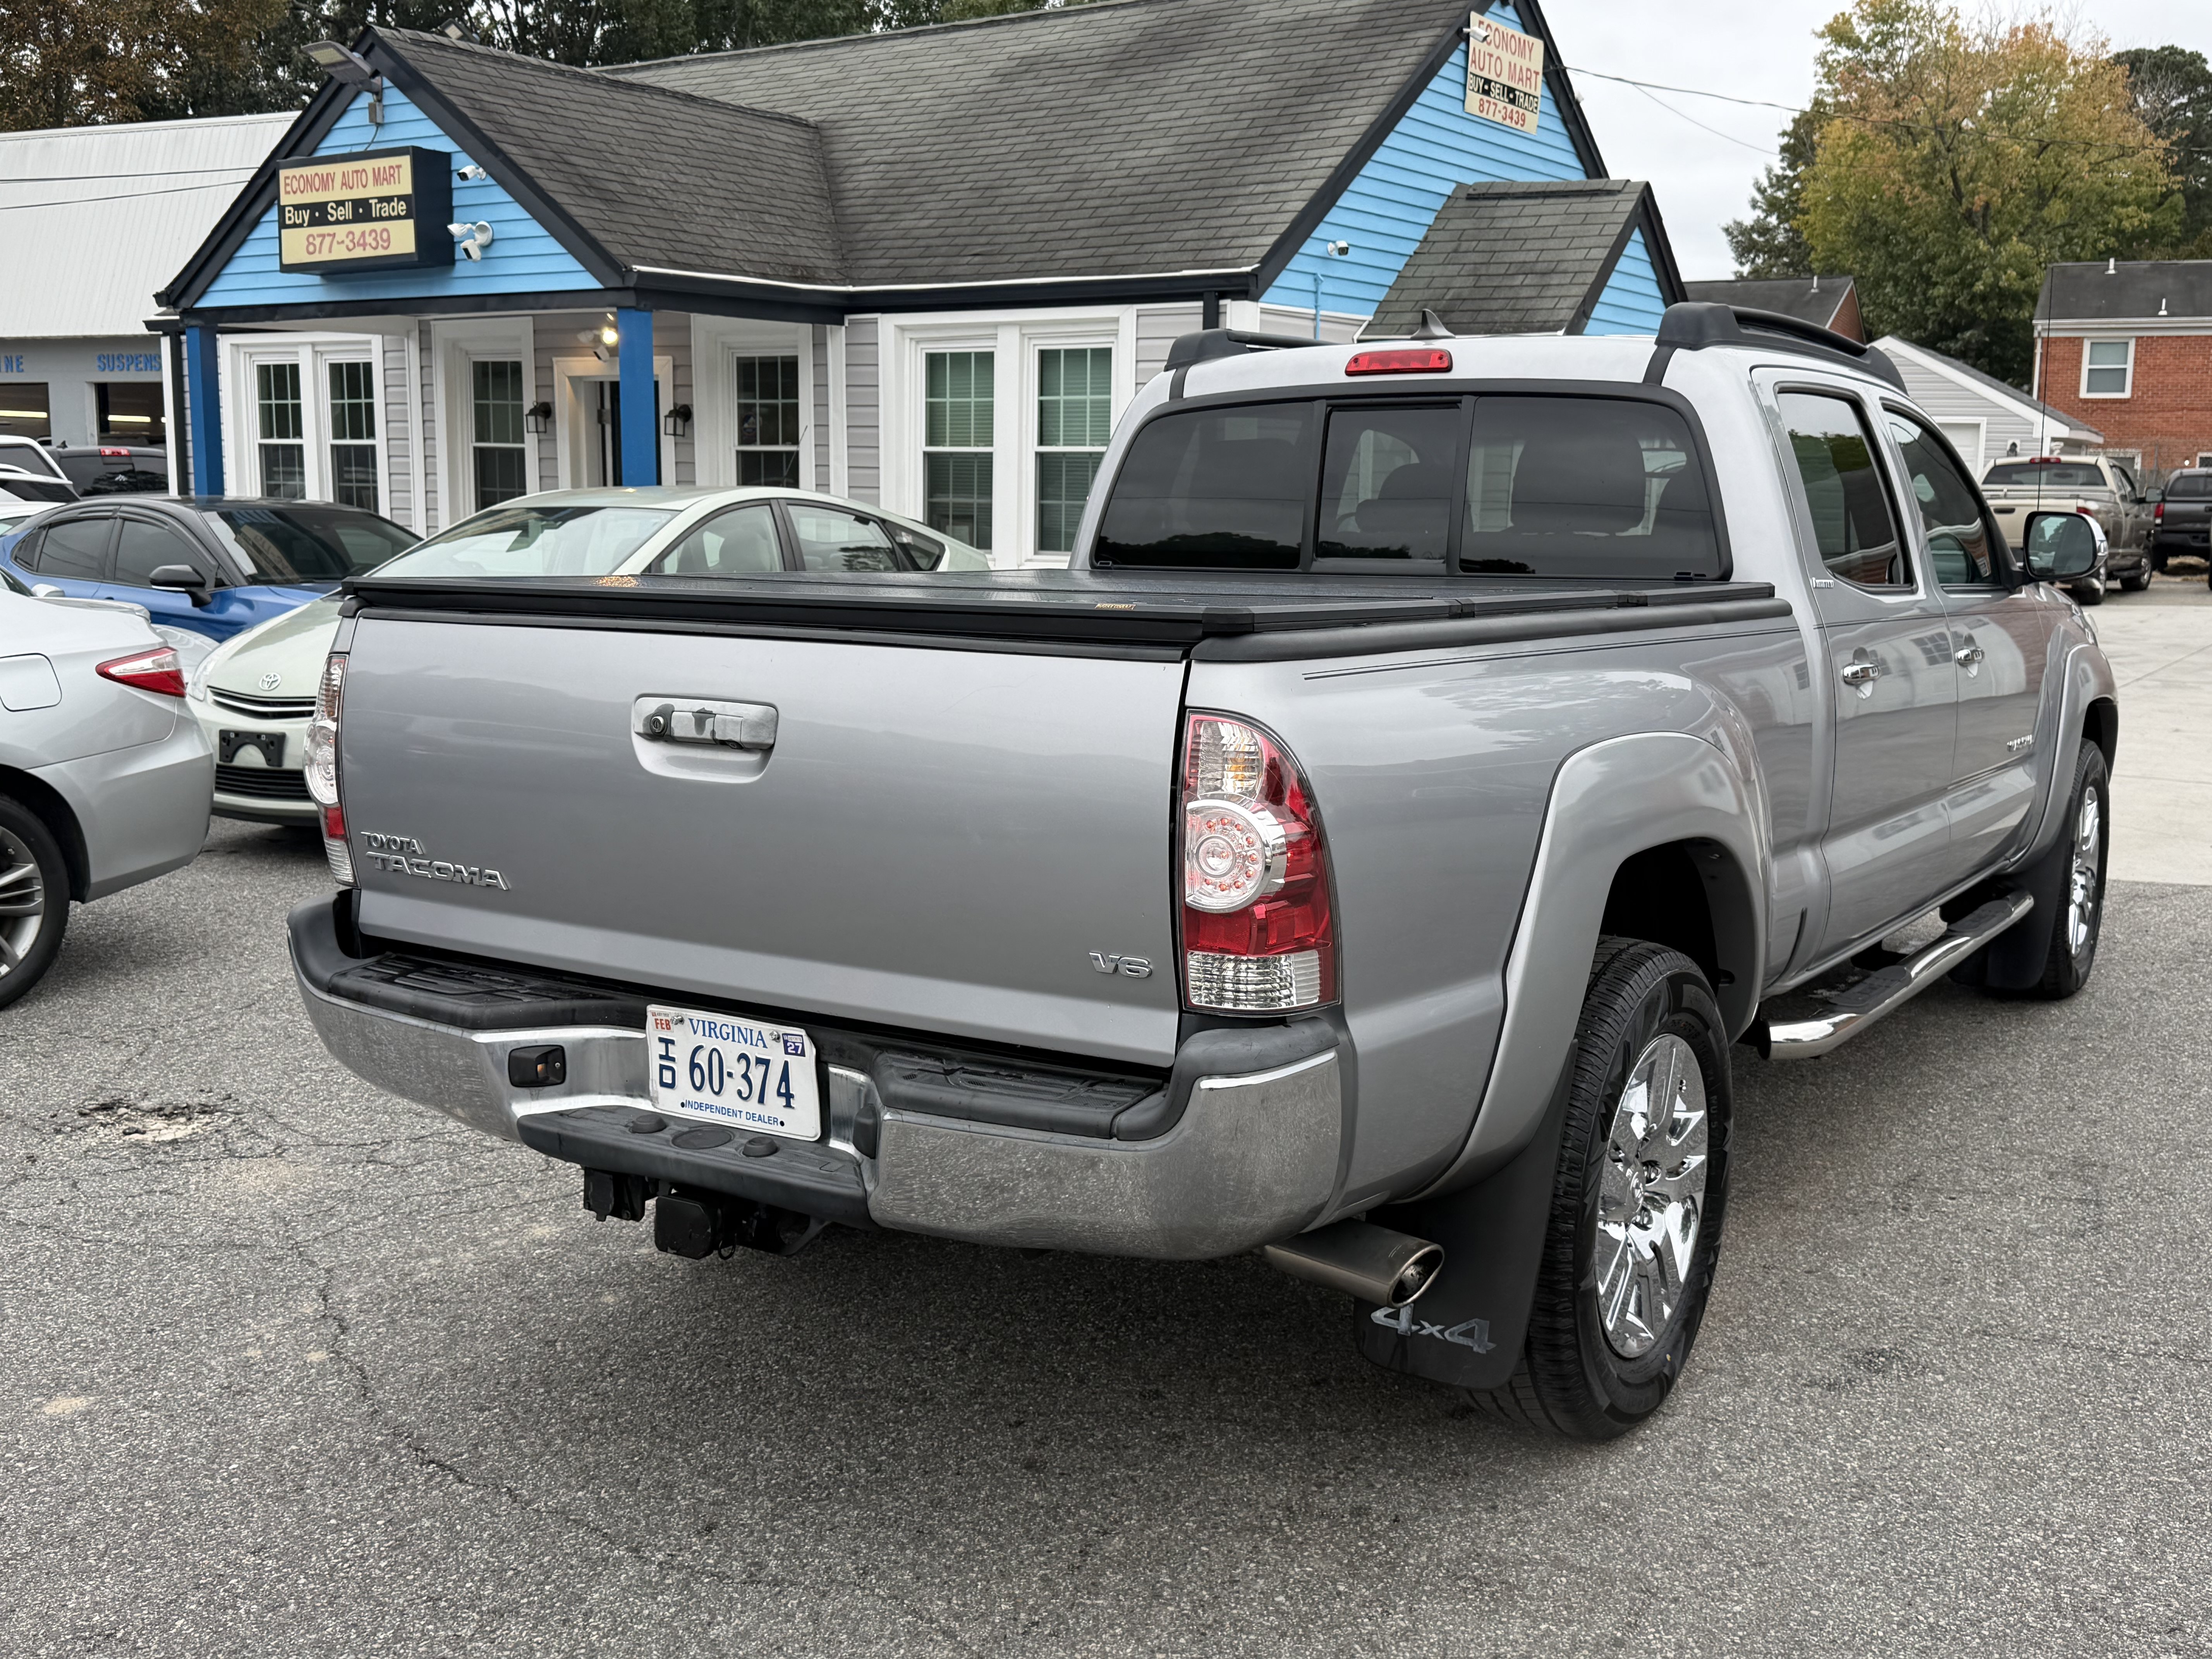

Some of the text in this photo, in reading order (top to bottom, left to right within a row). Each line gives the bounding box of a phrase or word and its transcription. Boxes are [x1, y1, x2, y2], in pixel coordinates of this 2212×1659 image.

[1470, 46, 1540, 92] AUTO MART
[1469, 74, 1539, 113] BUY SELL TRADE
[1479, 98, 1526, 127] 877-3439
[284, 164, 402, 194] ECONOMY AUTO MART
[285, 197, 407, 227] Buy Sell Trade
[306, 227, 391, 255] 877-3439
[96, 354, 162, 371] SUSPENS
[361, 831, 425, 855] TOYOTA
[365, 852, 511, 891] TACOMA
[1089, 952, 1152, 978] V6
[654, 1018, 671, 1030] FEB
[688, 1018, 768, 1049] VIRGINIA
[787, 1042, 802, 1054] 27
[689, 1044, 795, 1109] 60-374
[685, 1099, 779, 1126] INDEPENDENT DEALER
[1371, 1303, 1497, 1354] 4x4
